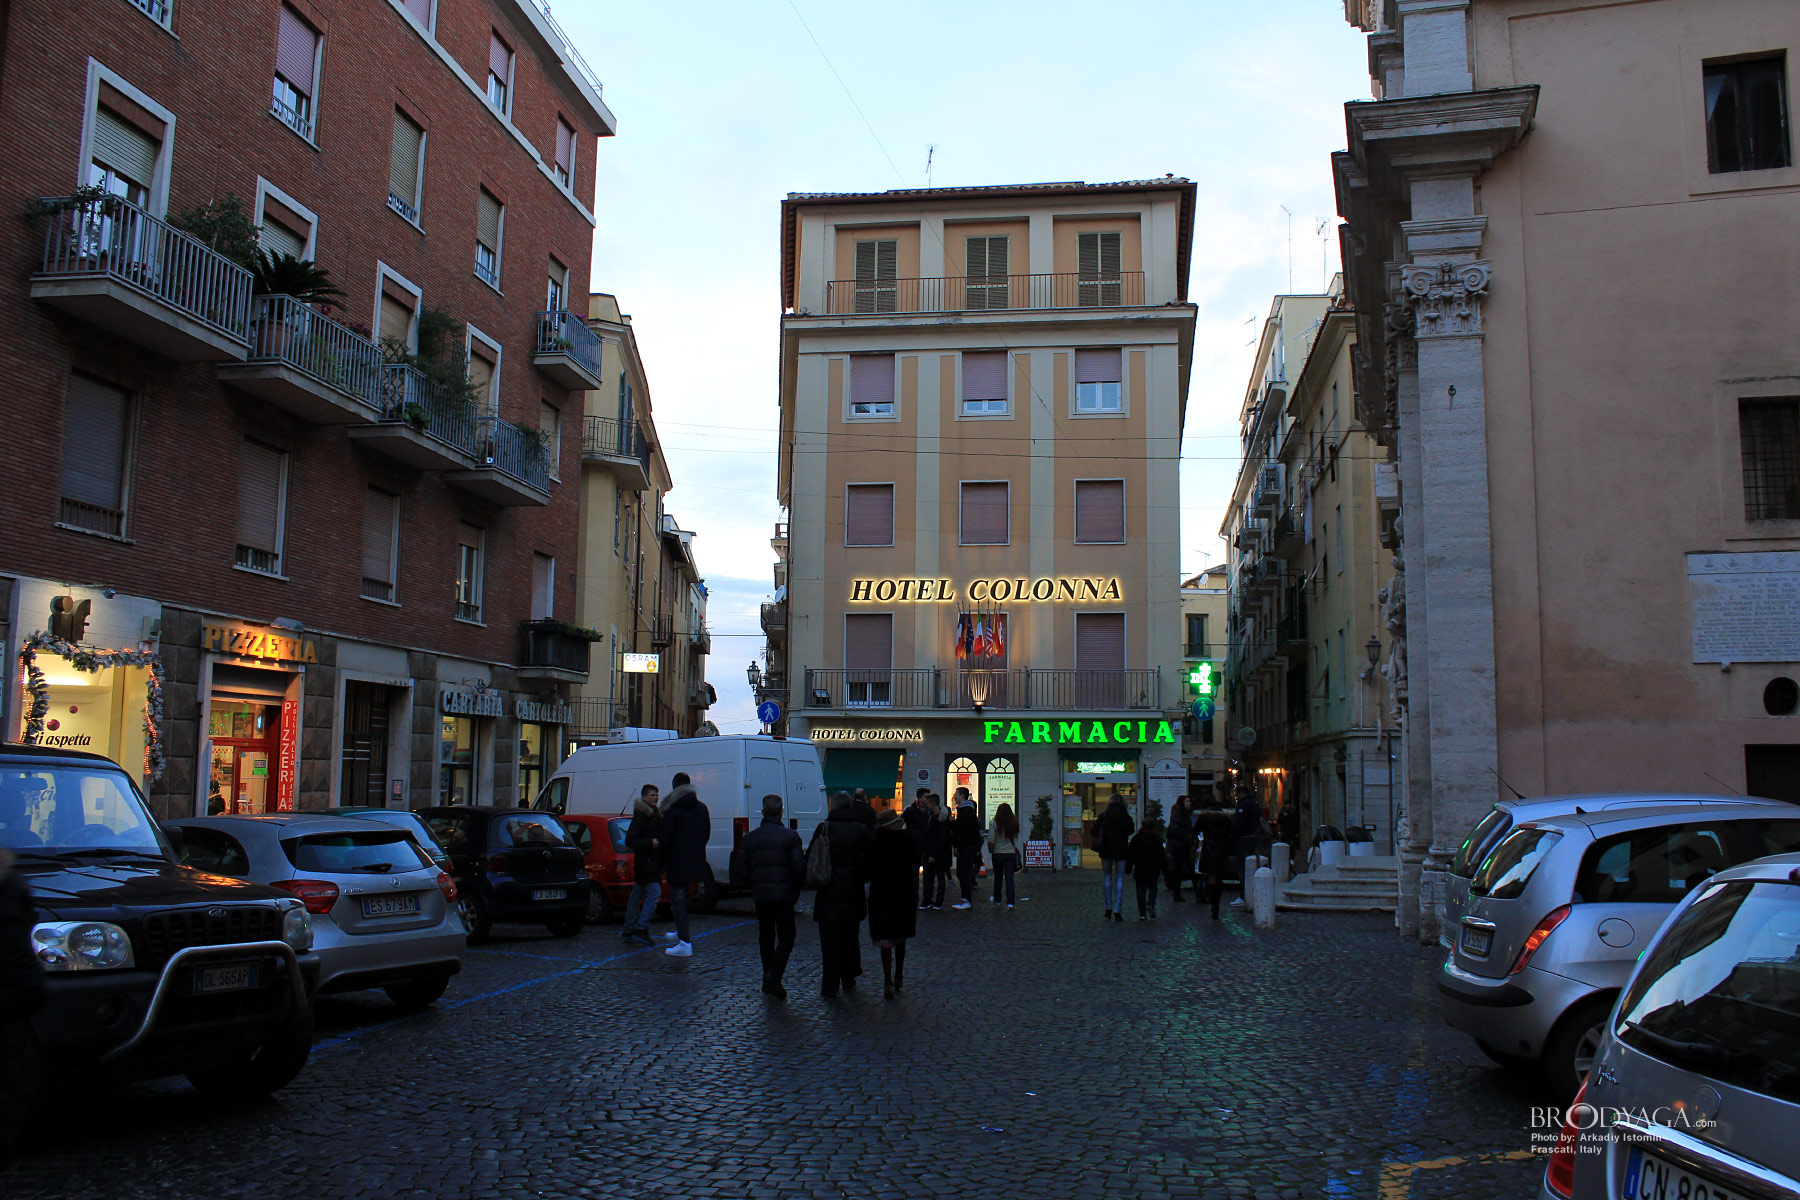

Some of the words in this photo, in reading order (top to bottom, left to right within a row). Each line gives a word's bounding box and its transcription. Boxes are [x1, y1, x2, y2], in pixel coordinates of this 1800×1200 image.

[849, 578, 955, 602] HOTEL
[969, 578, 1122, 602] COLONNA
[203, 623, 318, 664] PIZZERIA
[624, 653, 658, 662] OSRAM
[442, 689, 504, 717] CARTARIA
[515, 699, 573, 724] CARTOLERIA
[45, 733, 91, 748] aspetta
[811, 729, 856, 740] HOTEL
[859, 729, 923, 740] COLONNA
[983, 720, 1175, 744] FARMACIA
[278, 701, 292, 810] PIZZERIA
[370, 899, 383, 912] ES
[385, 896, 415, 911] 679AM
[204, 972, 216, 987] DL
[219, 968, 248, 986] 565AP
